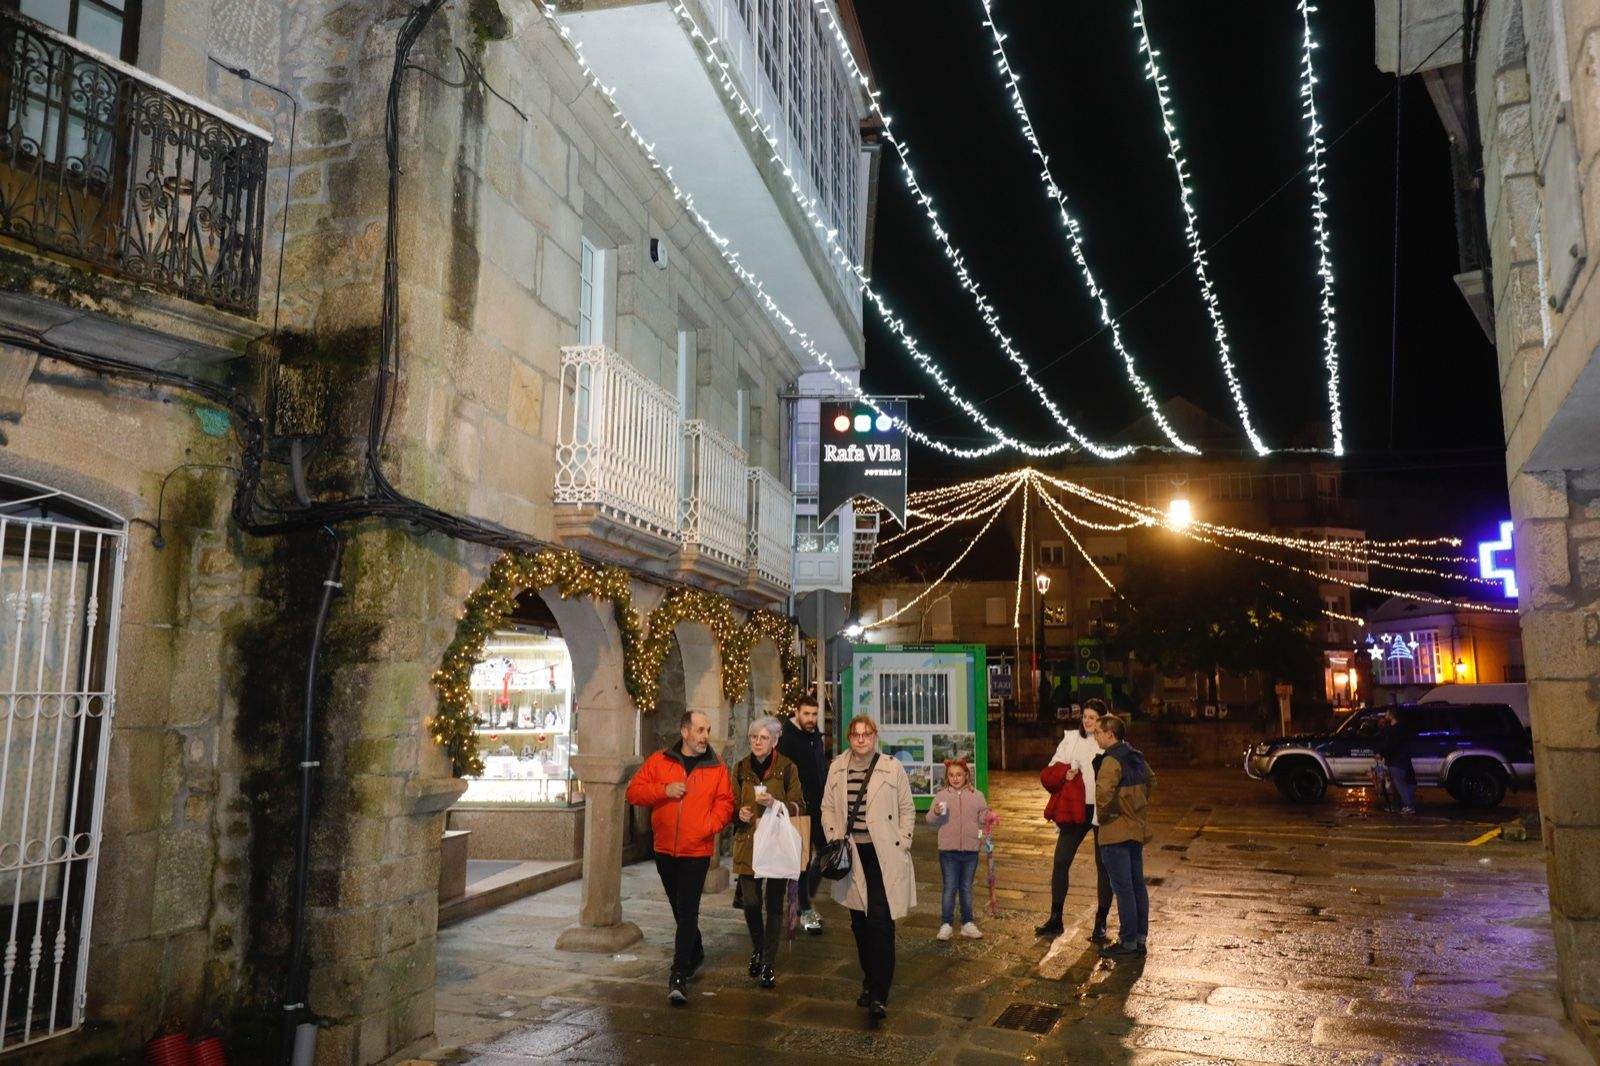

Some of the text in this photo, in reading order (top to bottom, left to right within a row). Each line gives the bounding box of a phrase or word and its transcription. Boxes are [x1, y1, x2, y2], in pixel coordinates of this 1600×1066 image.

[824, 444, 901, 462] Rafa Vila
[994, 681, 1011, 689] TAXI
